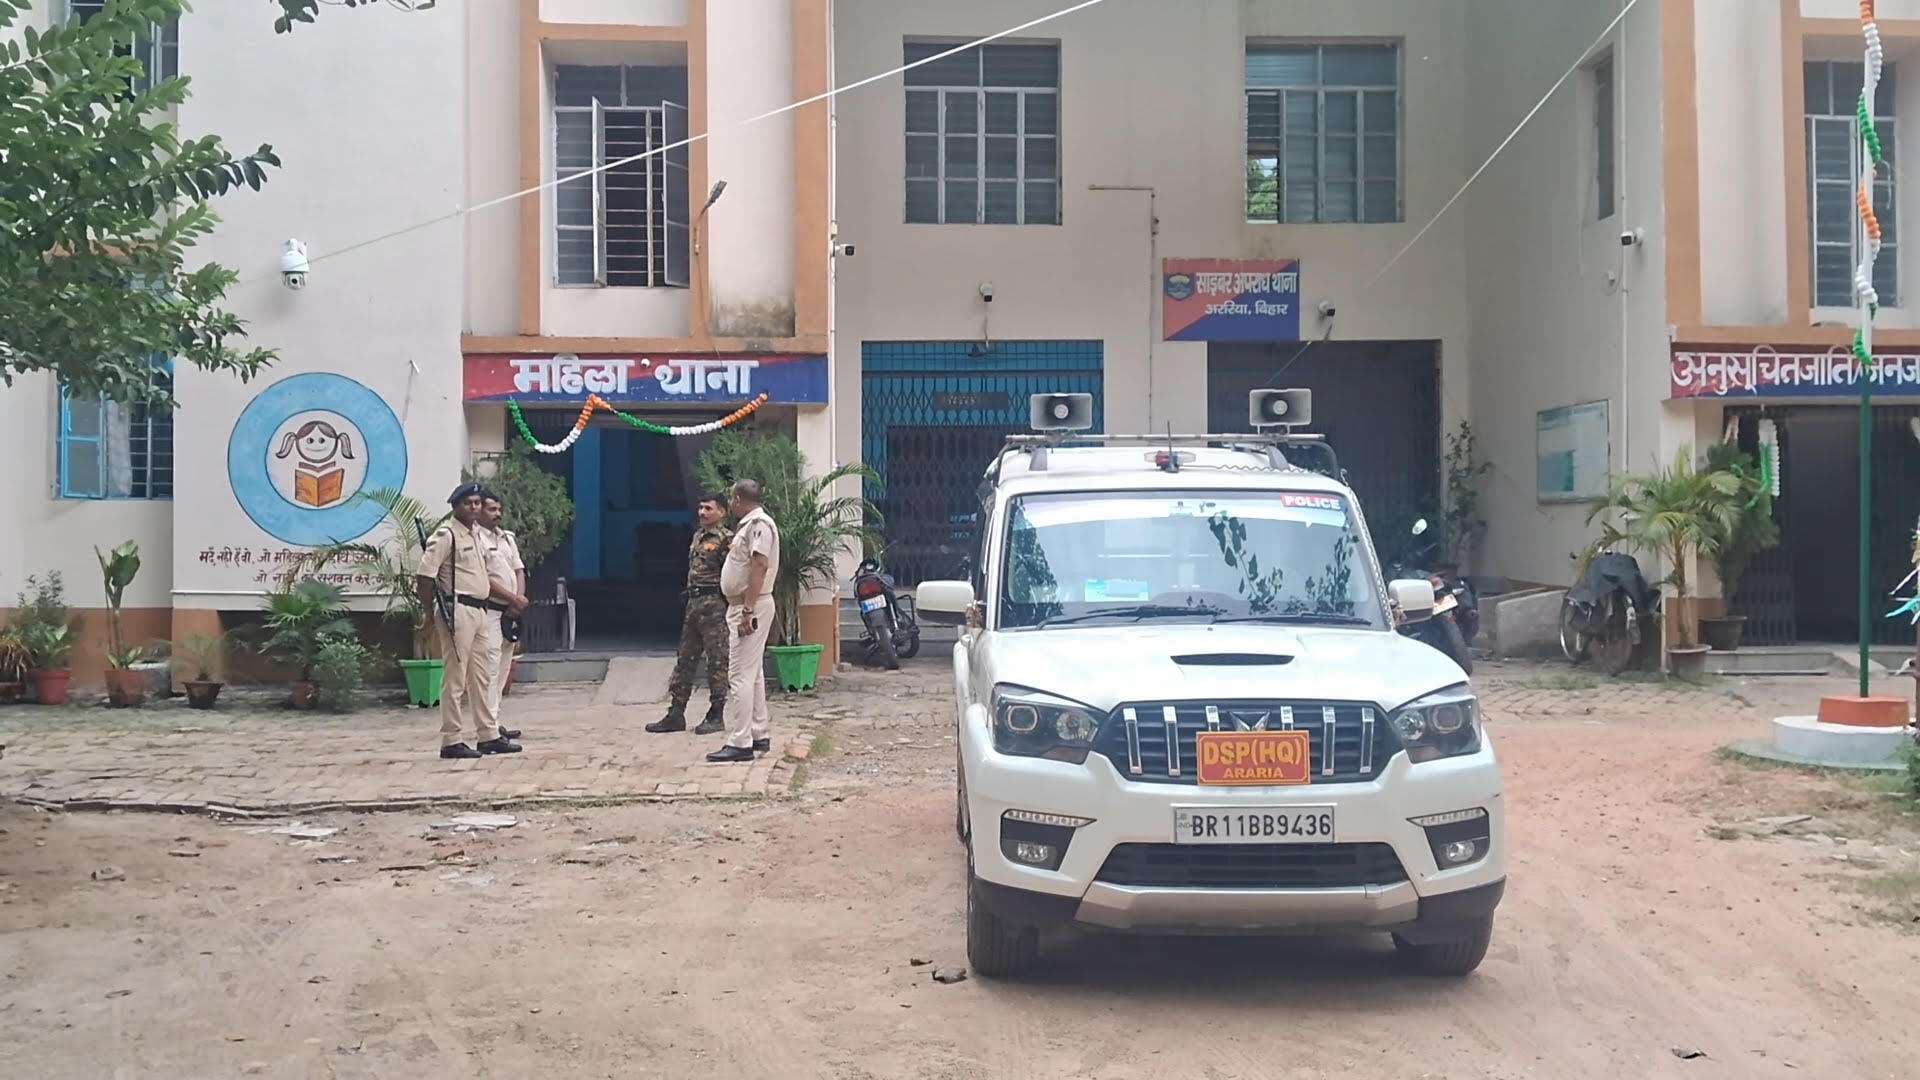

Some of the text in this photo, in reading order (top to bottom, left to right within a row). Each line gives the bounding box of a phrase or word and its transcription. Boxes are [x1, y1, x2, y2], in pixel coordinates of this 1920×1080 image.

[1196, 271, 1297, 296] साइबर अपराध थाना
[1204, 299, 1289, 316] अररिया, बिहार
[509, 353, 759, 394] महिला थाना
[1284, 494, 1342, 510] POLICE
[1203, 738, 1301, 766] DSP(HQ)
[1223, 767, 1284, 779] ARARIA
[1192, 814, 1331, 837] BR11BB9436
